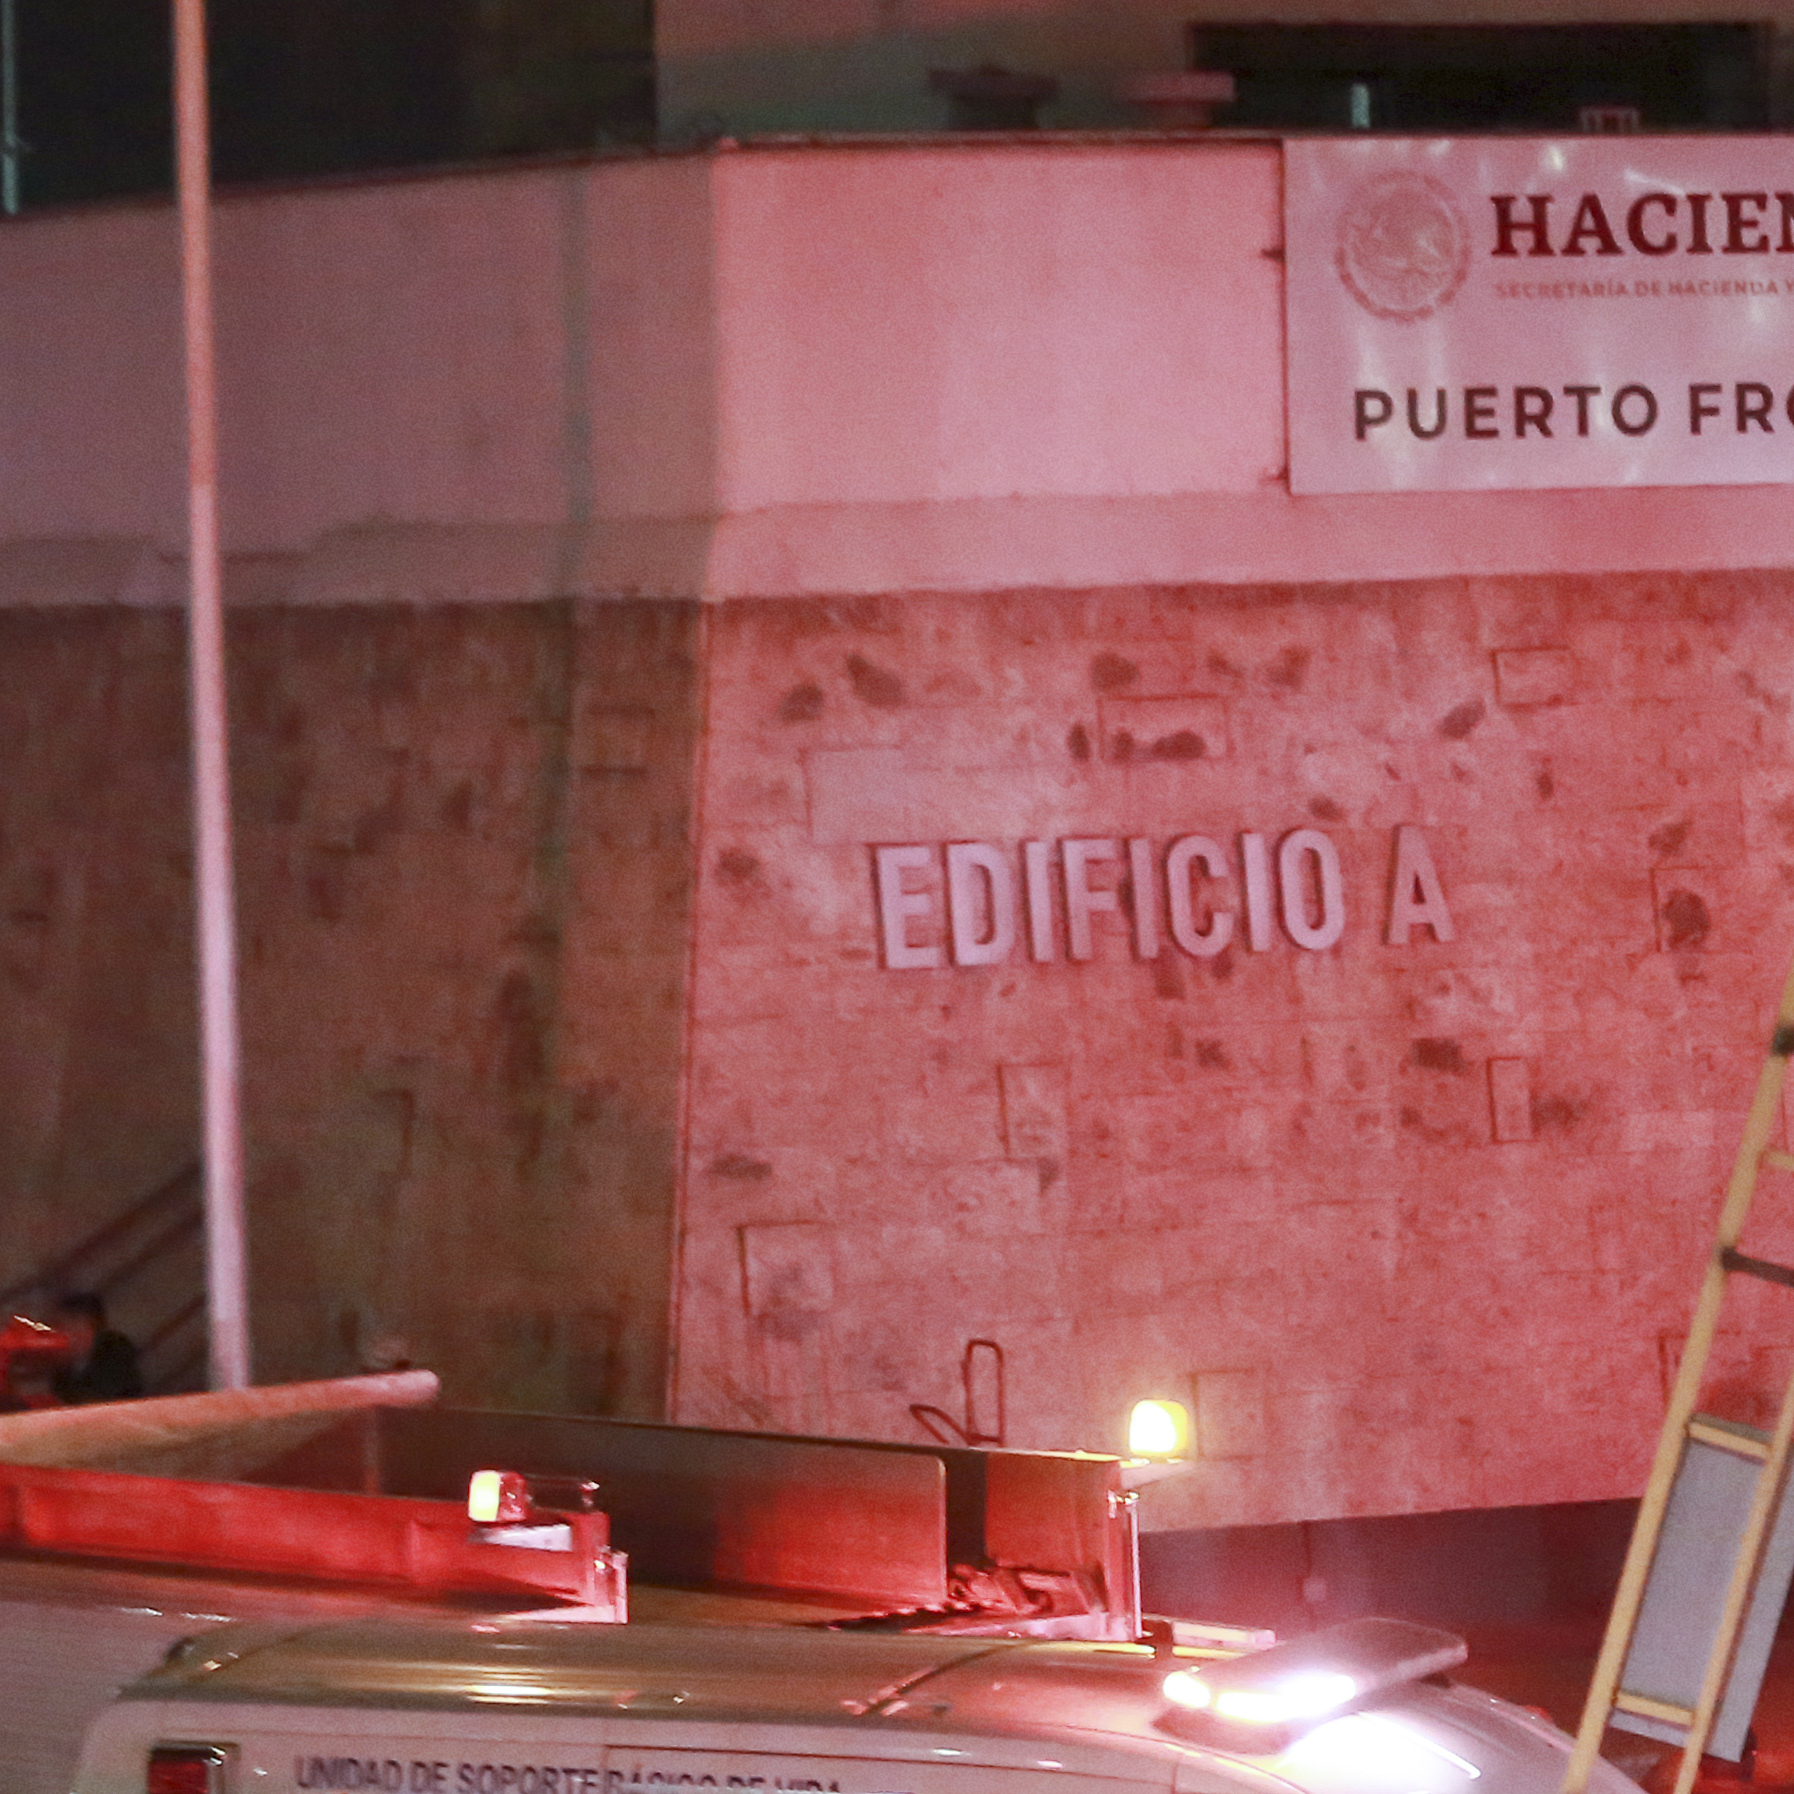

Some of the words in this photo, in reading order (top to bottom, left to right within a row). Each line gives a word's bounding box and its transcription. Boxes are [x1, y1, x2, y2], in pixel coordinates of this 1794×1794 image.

[1634, 280, 1661, 298] DE
[1668, 279, 1779, 297] HACIENDA
[1353, 382, 1660, 441] PUERTO
[873, 829, 1345, 969] EDIFICIO
[1386, 823, 1456, 945] A
[296, 1755, 401, 1792] UNIDAD
